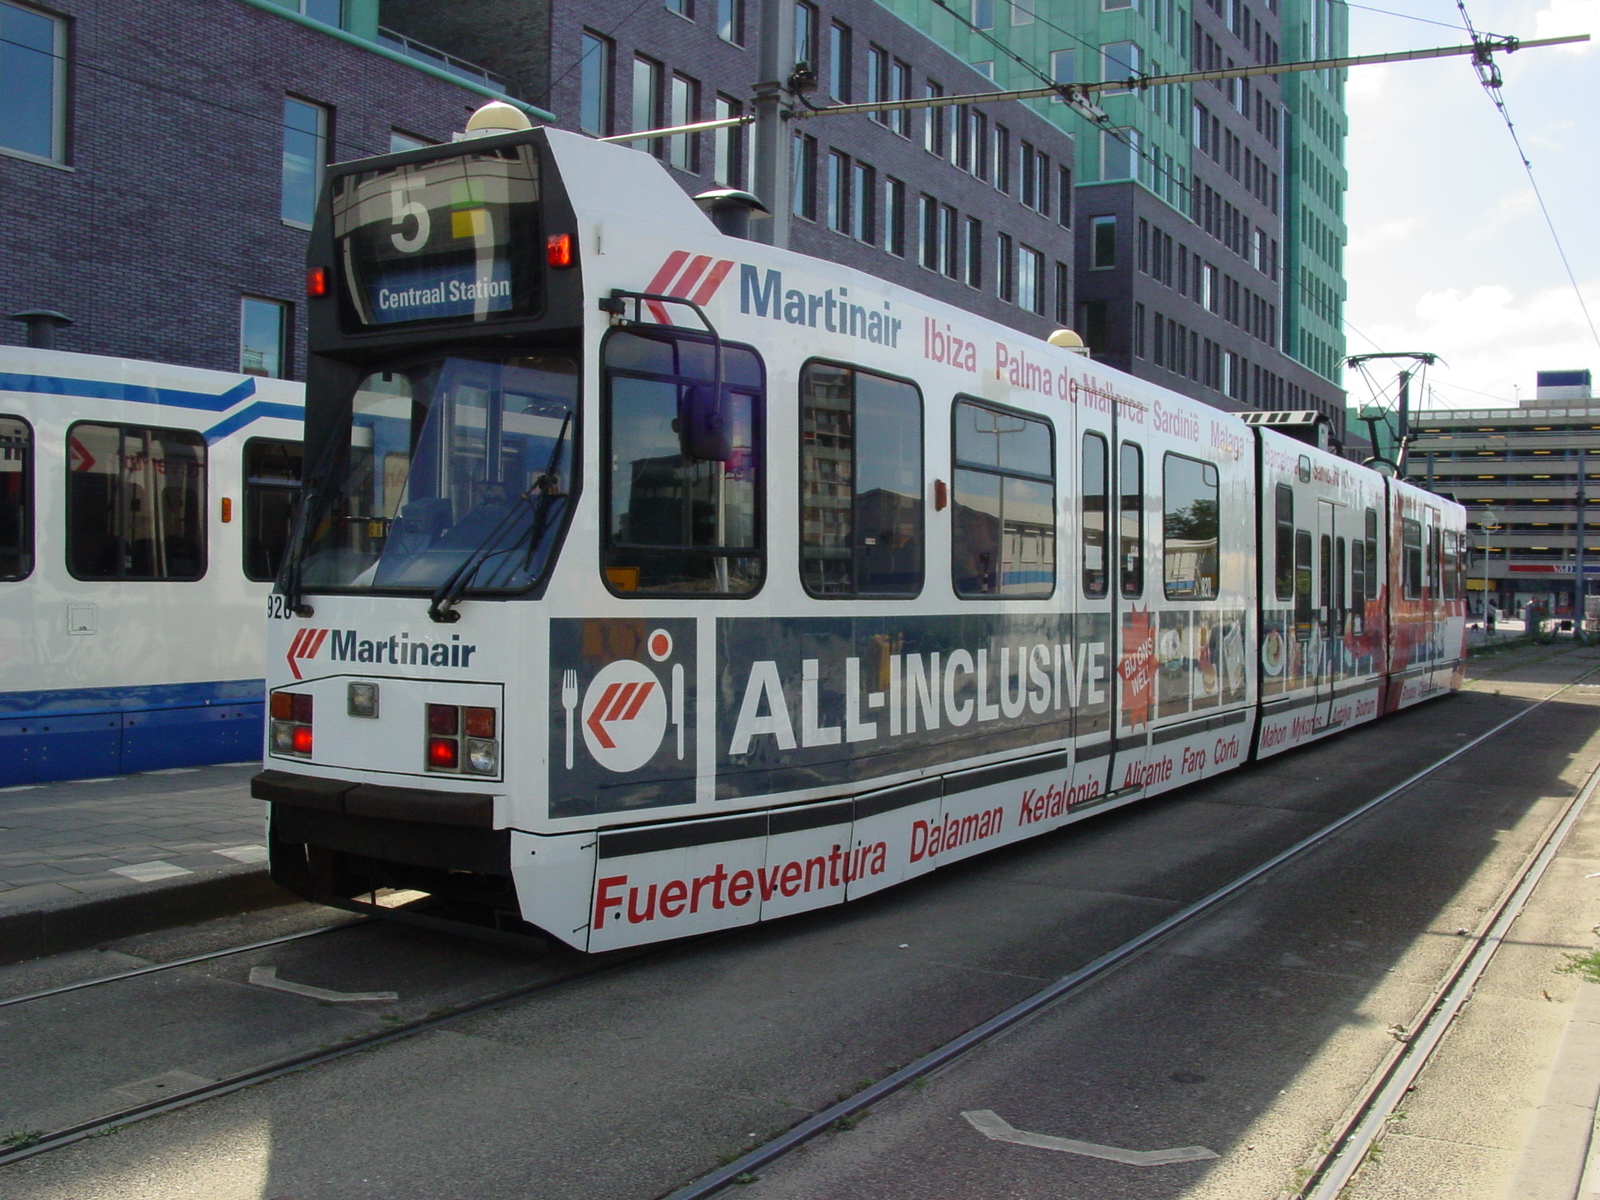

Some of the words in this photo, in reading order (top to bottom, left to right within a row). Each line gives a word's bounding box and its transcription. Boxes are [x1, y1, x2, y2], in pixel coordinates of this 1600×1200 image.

[391, 177, 430, 253] 5
[379, 282, 445, 310] Centraal
[450, 277, 510, 301] Station
[740, 263, 902, 349] Martinair
[924, 316, 976, 373] Ibiza
[995, 342, 1052, 396] Palma
[1058, 367, 1077, 403] de
[1153, 400, 1199, 442] Sardinië
[1211, 419, 1245, 461] Malaga
[331, 629, 476, 668] Martinair
[729, 642, 1105, 755] ALL-INCLUSIVE
[593, 841, 887, 930] Fuerteventura
[909, 806, 1003, 863] Dalaman
[1018, 773, 1099, 826] Kefalonia
[1124, 754, 1172, 788] Alicante
[1181, 746, 1205, 775] Faro
[1214, 735, 1240, 765] Corfu
[1260, 723, 1287, 750] Mahon
